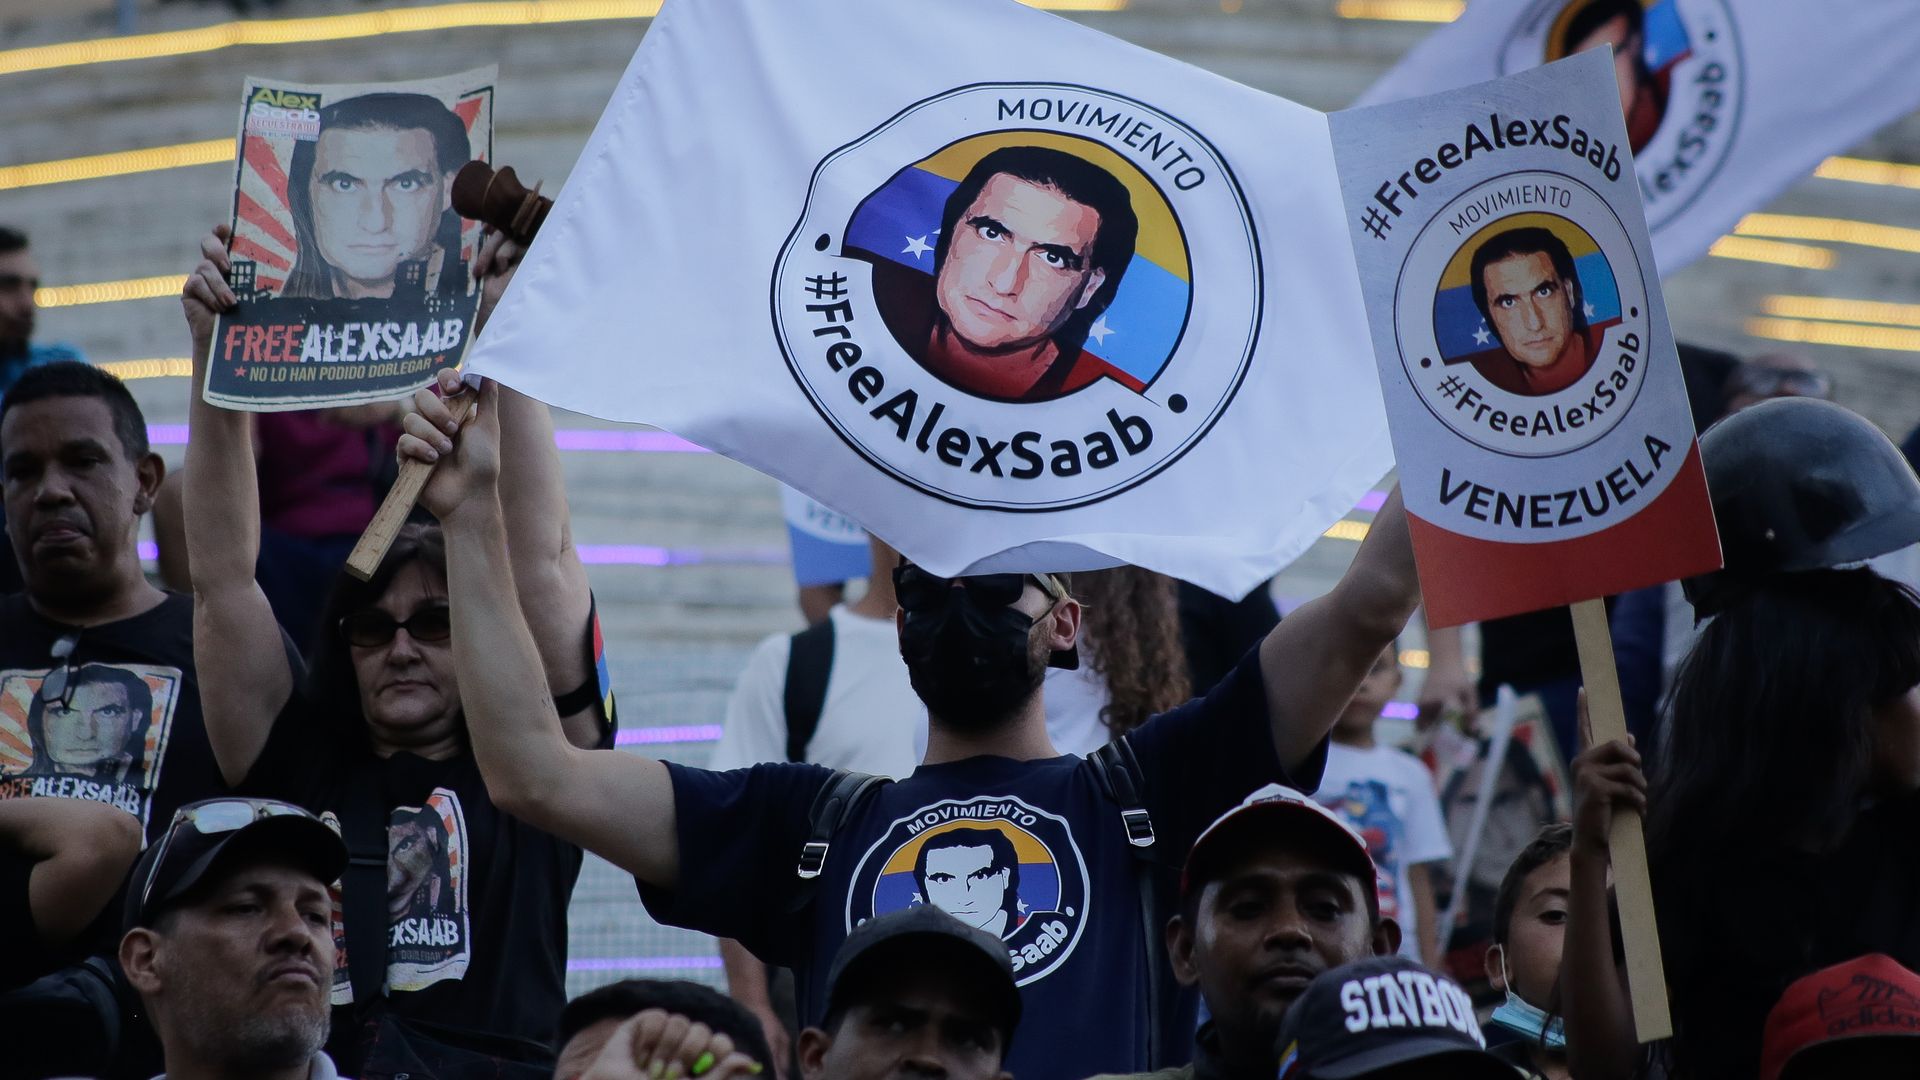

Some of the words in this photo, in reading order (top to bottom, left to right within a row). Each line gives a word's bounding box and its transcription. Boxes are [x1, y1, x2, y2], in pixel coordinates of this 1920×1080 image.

[253, 88, 317, 110] Alex
[253, 102, 320, 121] Saab
[1640, 63, 1726, 202] lexSaab
[998, 99, 1206, 190] MOVIMIENTO
[1361, 113, 1621, 241] #FreeAlexSaab
[1449, 185, 1572, 236] MOVIMIENTO
[250, 366, 268, 382] NO
[271, 366, 287, 382] LO
[290, 364, 317, 382] HAN
[320, 362, 366, 381] PODIDO
[369, 357, 432, 376] DOBLEGAR
[805, 271, 1154, 480] #FreeAlexSaab
[1437, 332, 1640, 437] #FreeAlexSaab
[1440, 434, 1672, 529] VENEZUELA
[906, 804, 1037, 835] MOVIMIENTO
[1008, 920, 1068, 972] Saab
